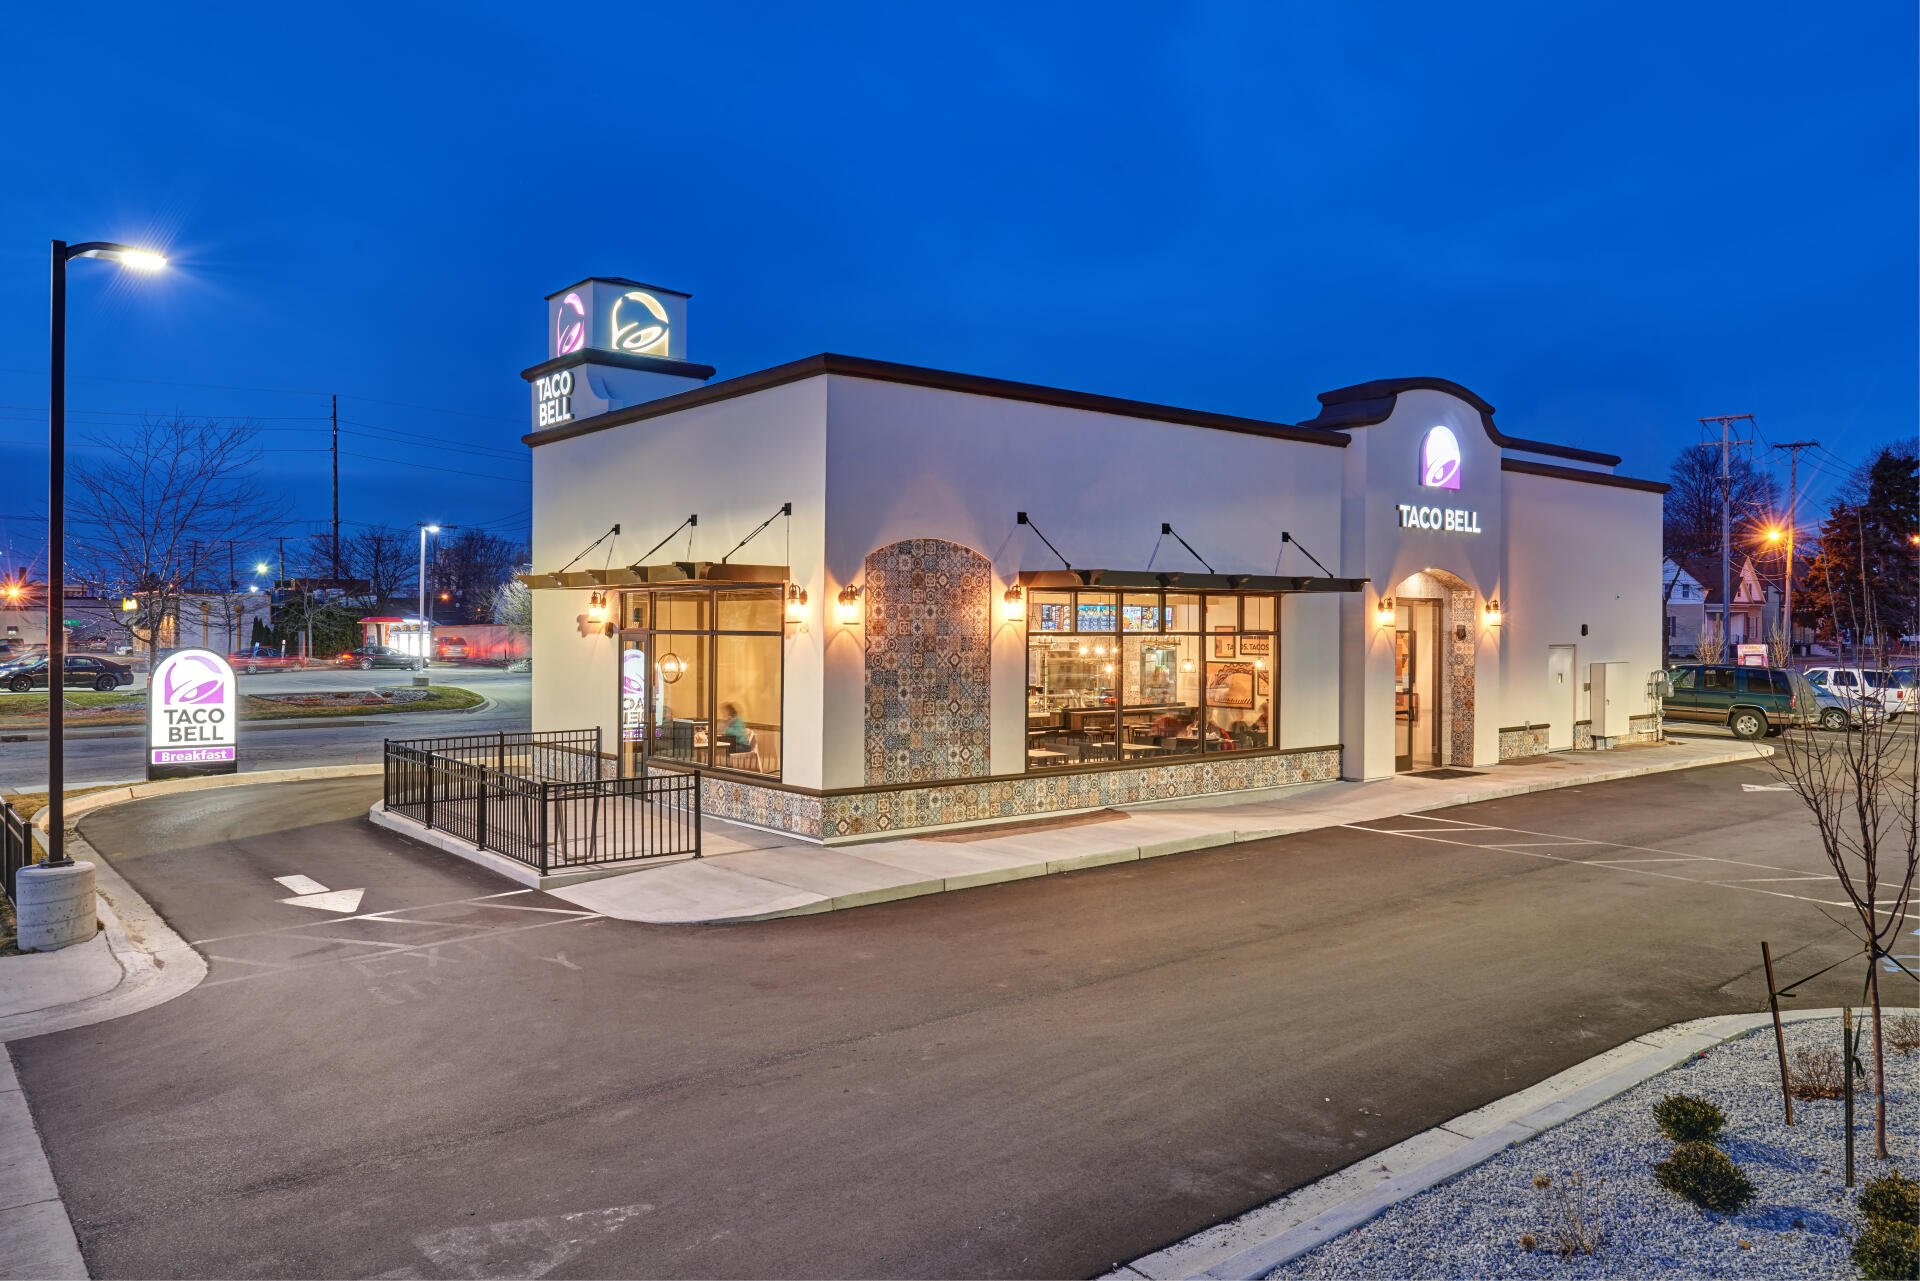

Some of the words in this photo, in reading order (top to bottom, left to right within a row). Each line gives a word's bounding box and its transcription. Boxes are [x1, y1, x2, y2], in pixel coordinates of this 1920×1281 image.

[537, 370, 573, 399] TACO
[539, 398, 573, 427] BELL
[1399, 504, 1442, 530] TACO
[1445, 508, 1482, 533] BELL
[163, 708, 225, 725] TACO
[168, 725, 224, 742] BELL
[161, 749, 227, 762] Breakfast
